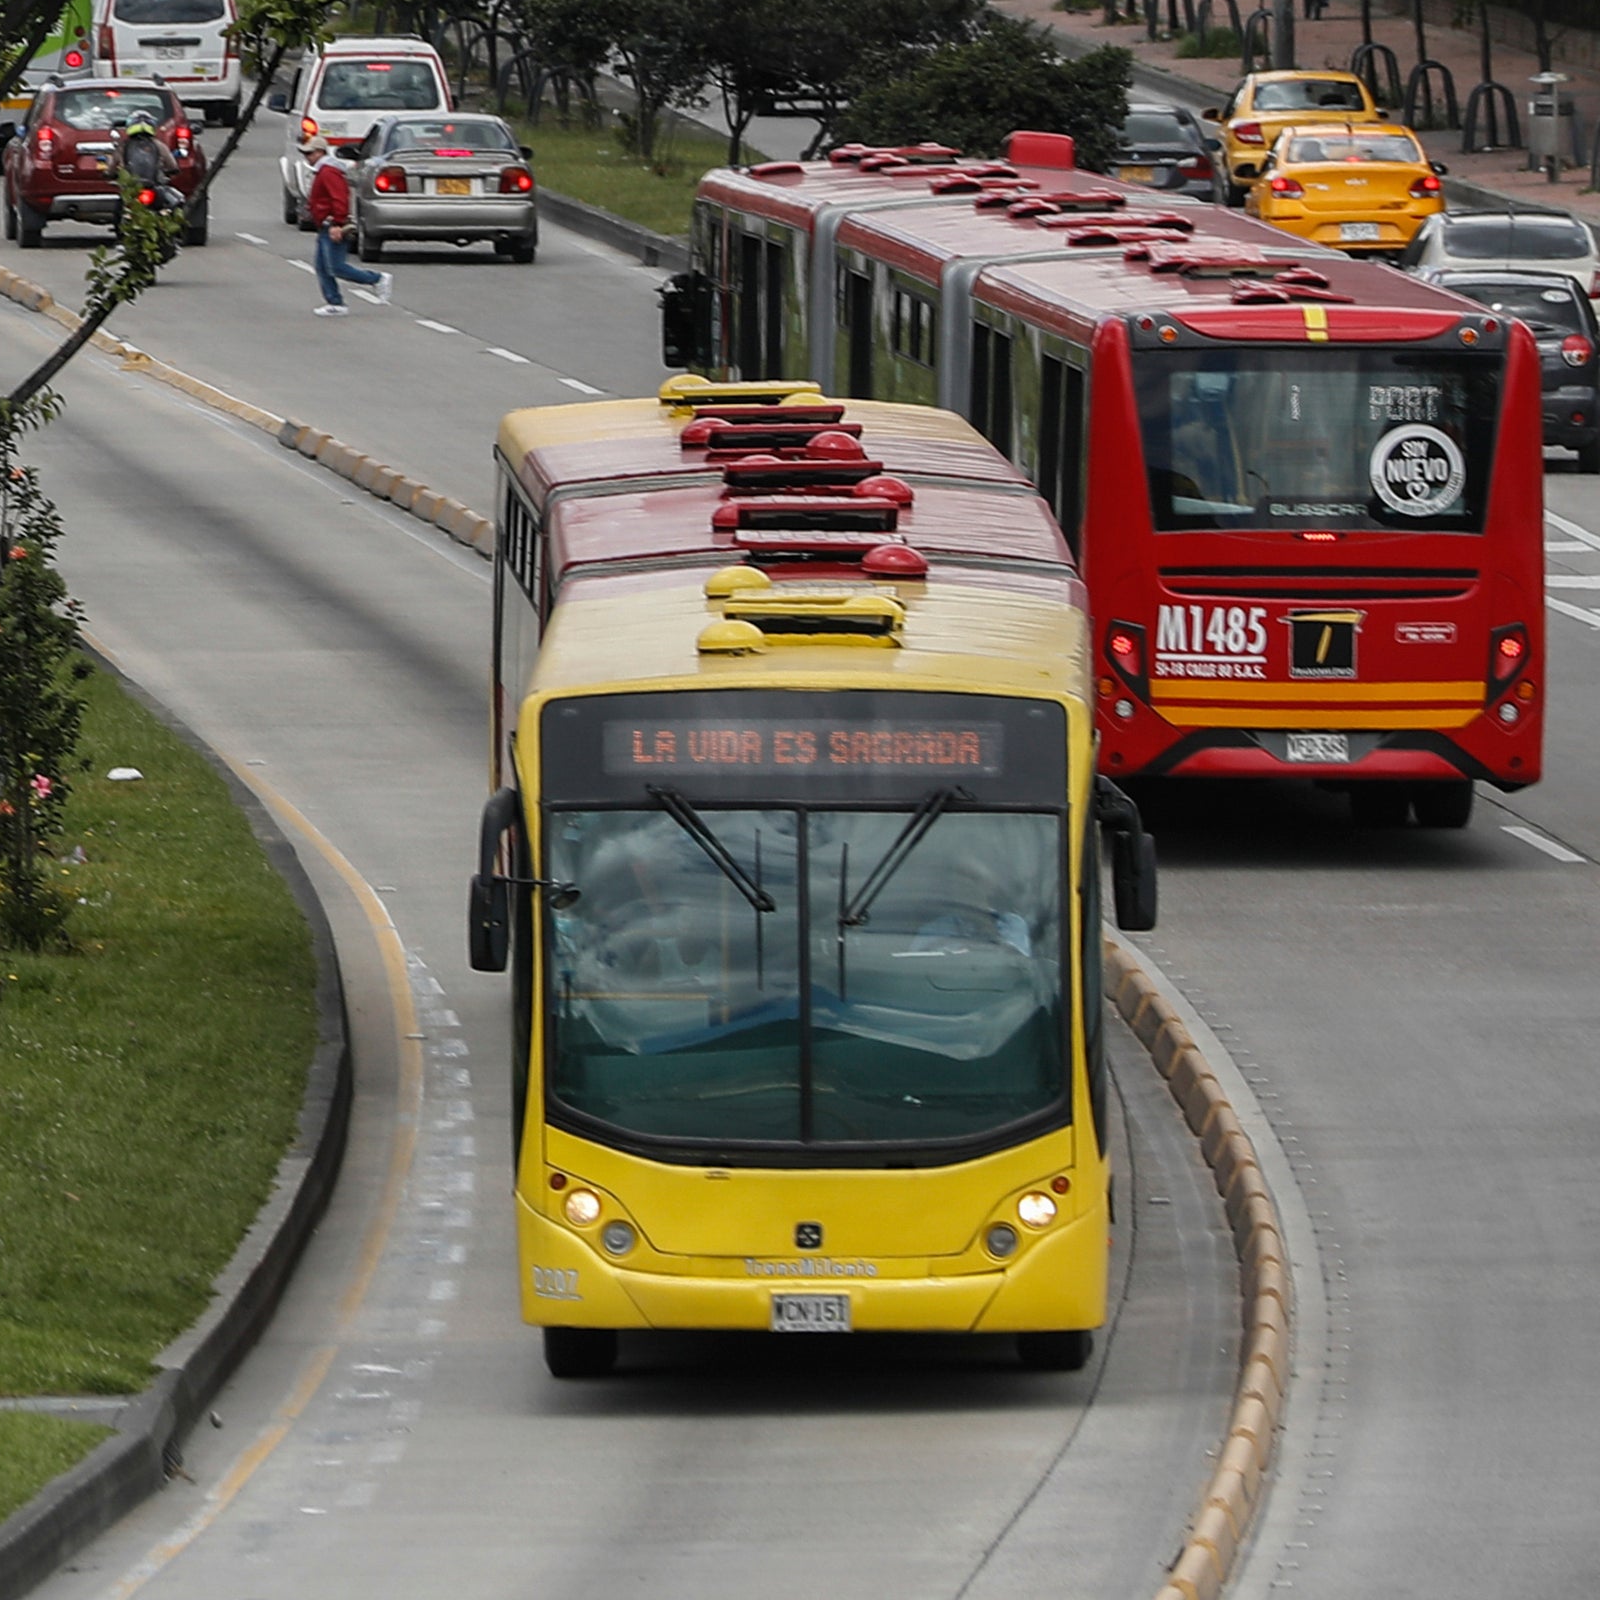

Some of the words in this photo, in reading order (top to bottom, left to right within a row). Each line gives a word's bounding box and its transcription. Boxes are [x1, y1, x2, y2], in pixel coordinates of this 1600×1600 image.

[1401, 440, 1429, 458] SOY
[1386, 457, 1448, 483] NUEVO
[1156, 603, 1267, 654] M1485
[632, 729, 677, 764] LA
[687, 729, 763, 764] VIDA
[773, 730, 817, 764] ES
[828, 730, 981, 765] SAGRADA
[745, 1258, 879, 1277] TransMilenio
